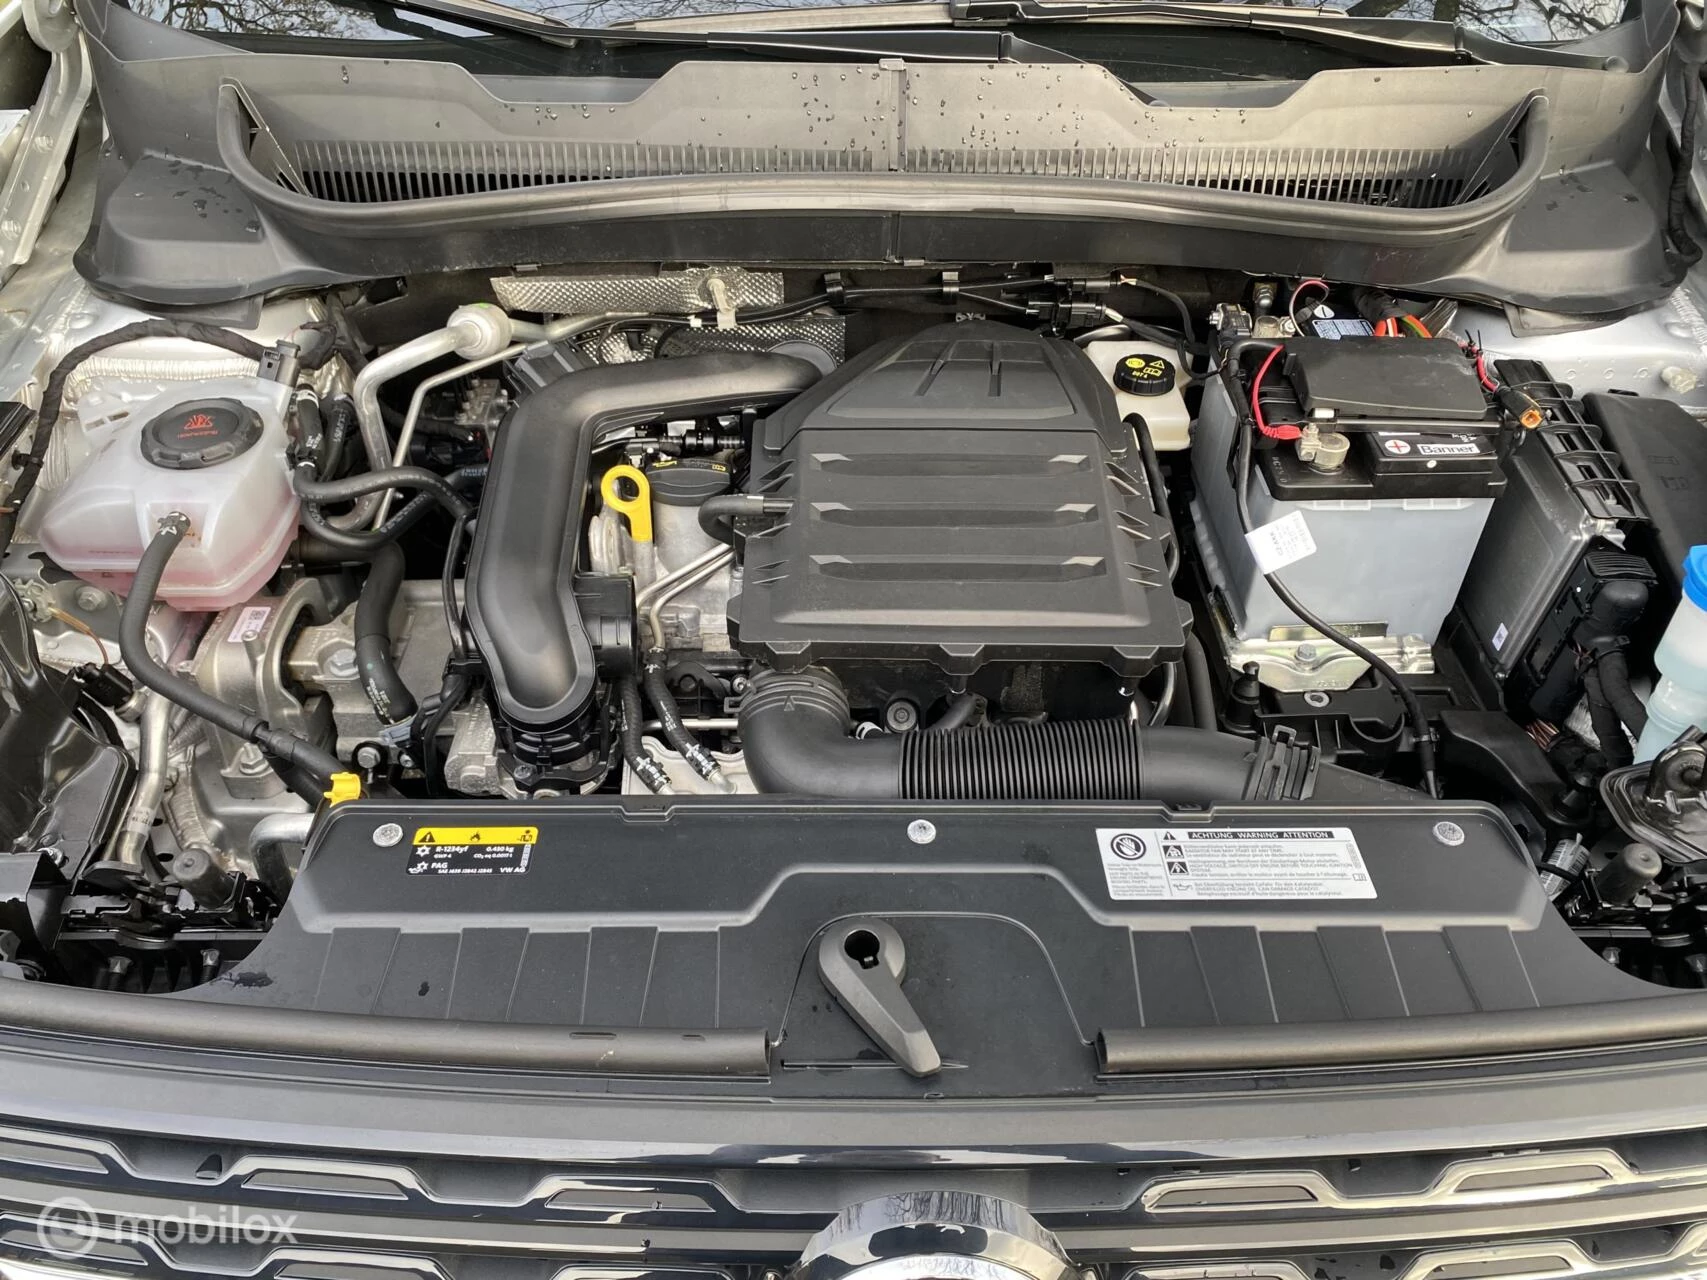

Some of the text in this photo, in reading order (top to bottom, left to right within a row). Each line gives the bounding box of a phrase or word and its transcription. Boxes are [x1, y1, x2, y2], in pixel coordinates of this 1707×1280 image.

[1421, 445, 1475, 454] Banner
[1191, 831, 1329, 840] ACHTUNG WARNING ATTENTION
[435, 846, 469, 854] R-1234yf
[505, 846, 515, 854] kg
